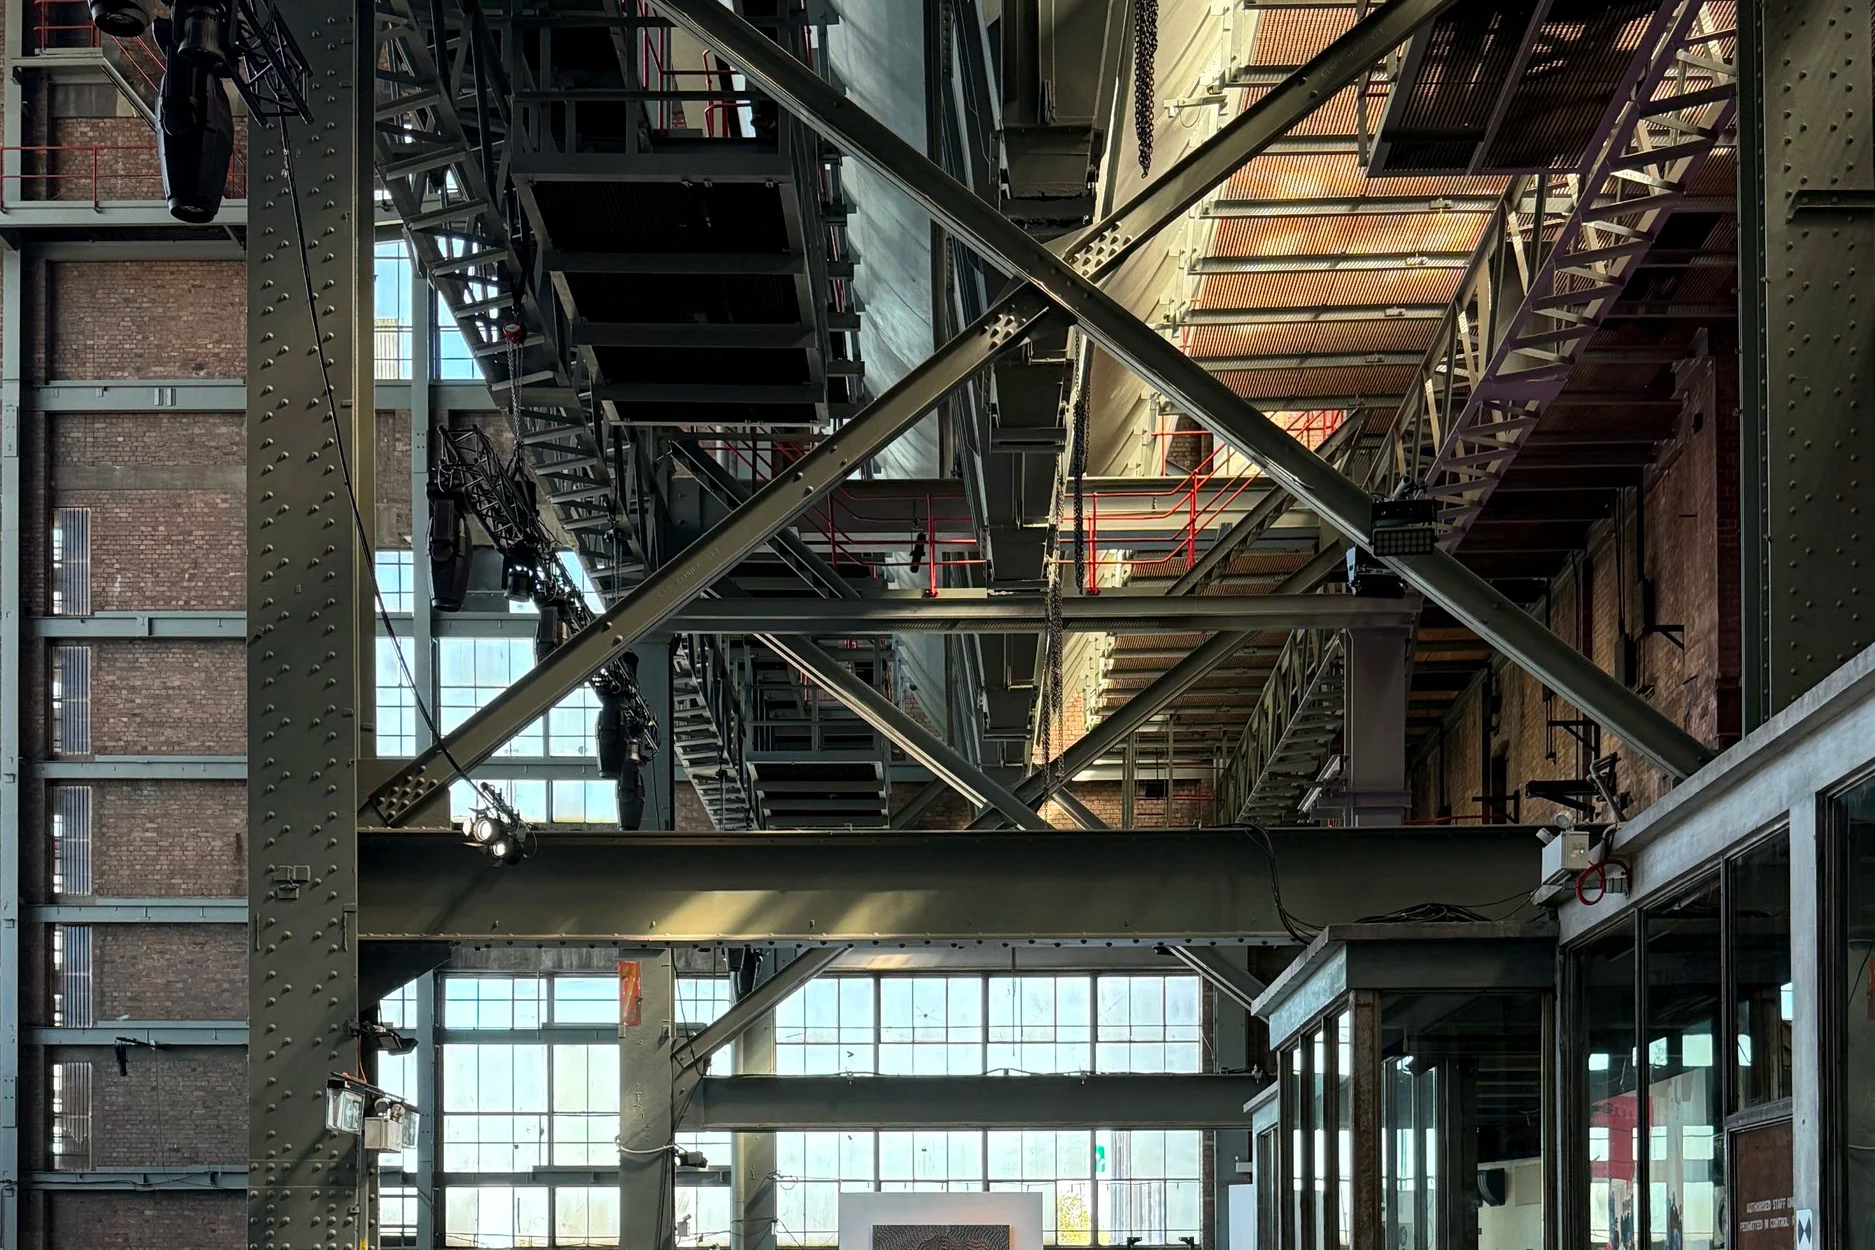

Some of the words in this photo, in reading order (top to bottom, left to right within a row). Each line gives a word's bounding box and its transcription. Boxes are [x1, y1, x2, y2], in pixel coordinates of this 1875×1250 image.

[1773, 1198, 1786, 1210] STAFF
[1740, 1220, 1763, 1232] PERMITTED
[1764, 1218, 1769, 1230] IN
[1770, 1217, 1789, 1229] CONTROL
